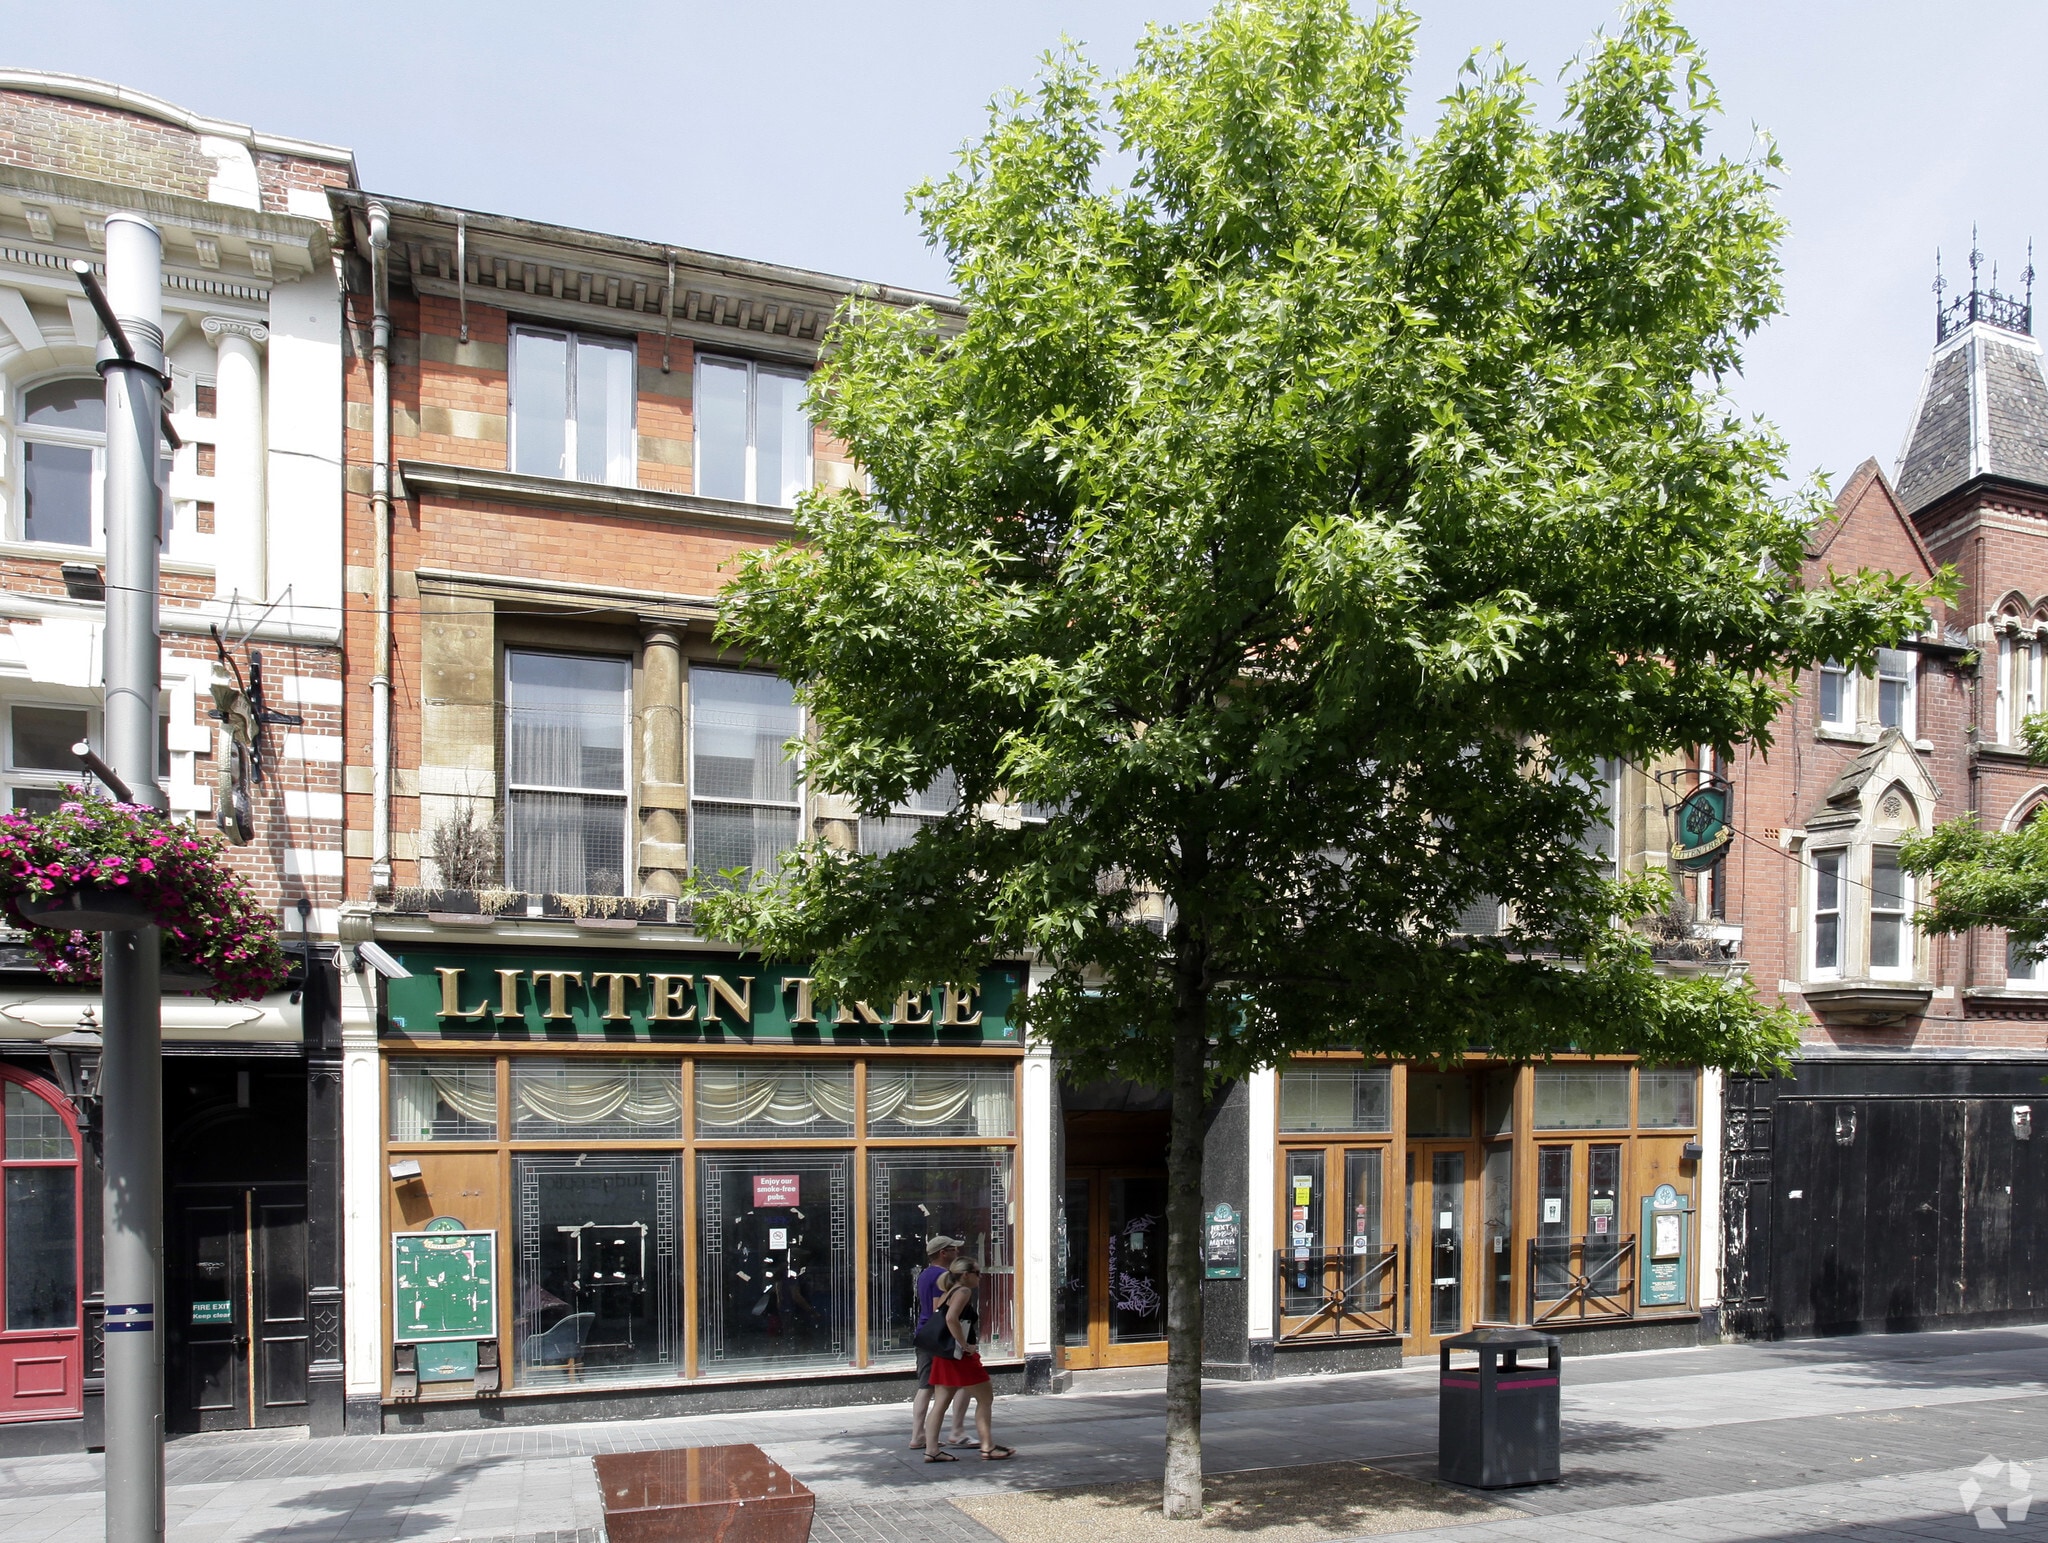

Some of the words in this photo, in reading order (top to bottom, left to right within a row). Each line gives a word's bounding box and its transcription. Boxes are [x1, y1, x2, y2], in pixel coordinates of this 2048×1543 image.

[1674, 848, 1701, 859] LITTEN
[434, 967, 756, 1023] LITTEN
[761, 1177, 780, 1186] Enjoy
[757, 1185, 796, 1193] smoke-free
[767, 1193, 786, 1202] pubs.
